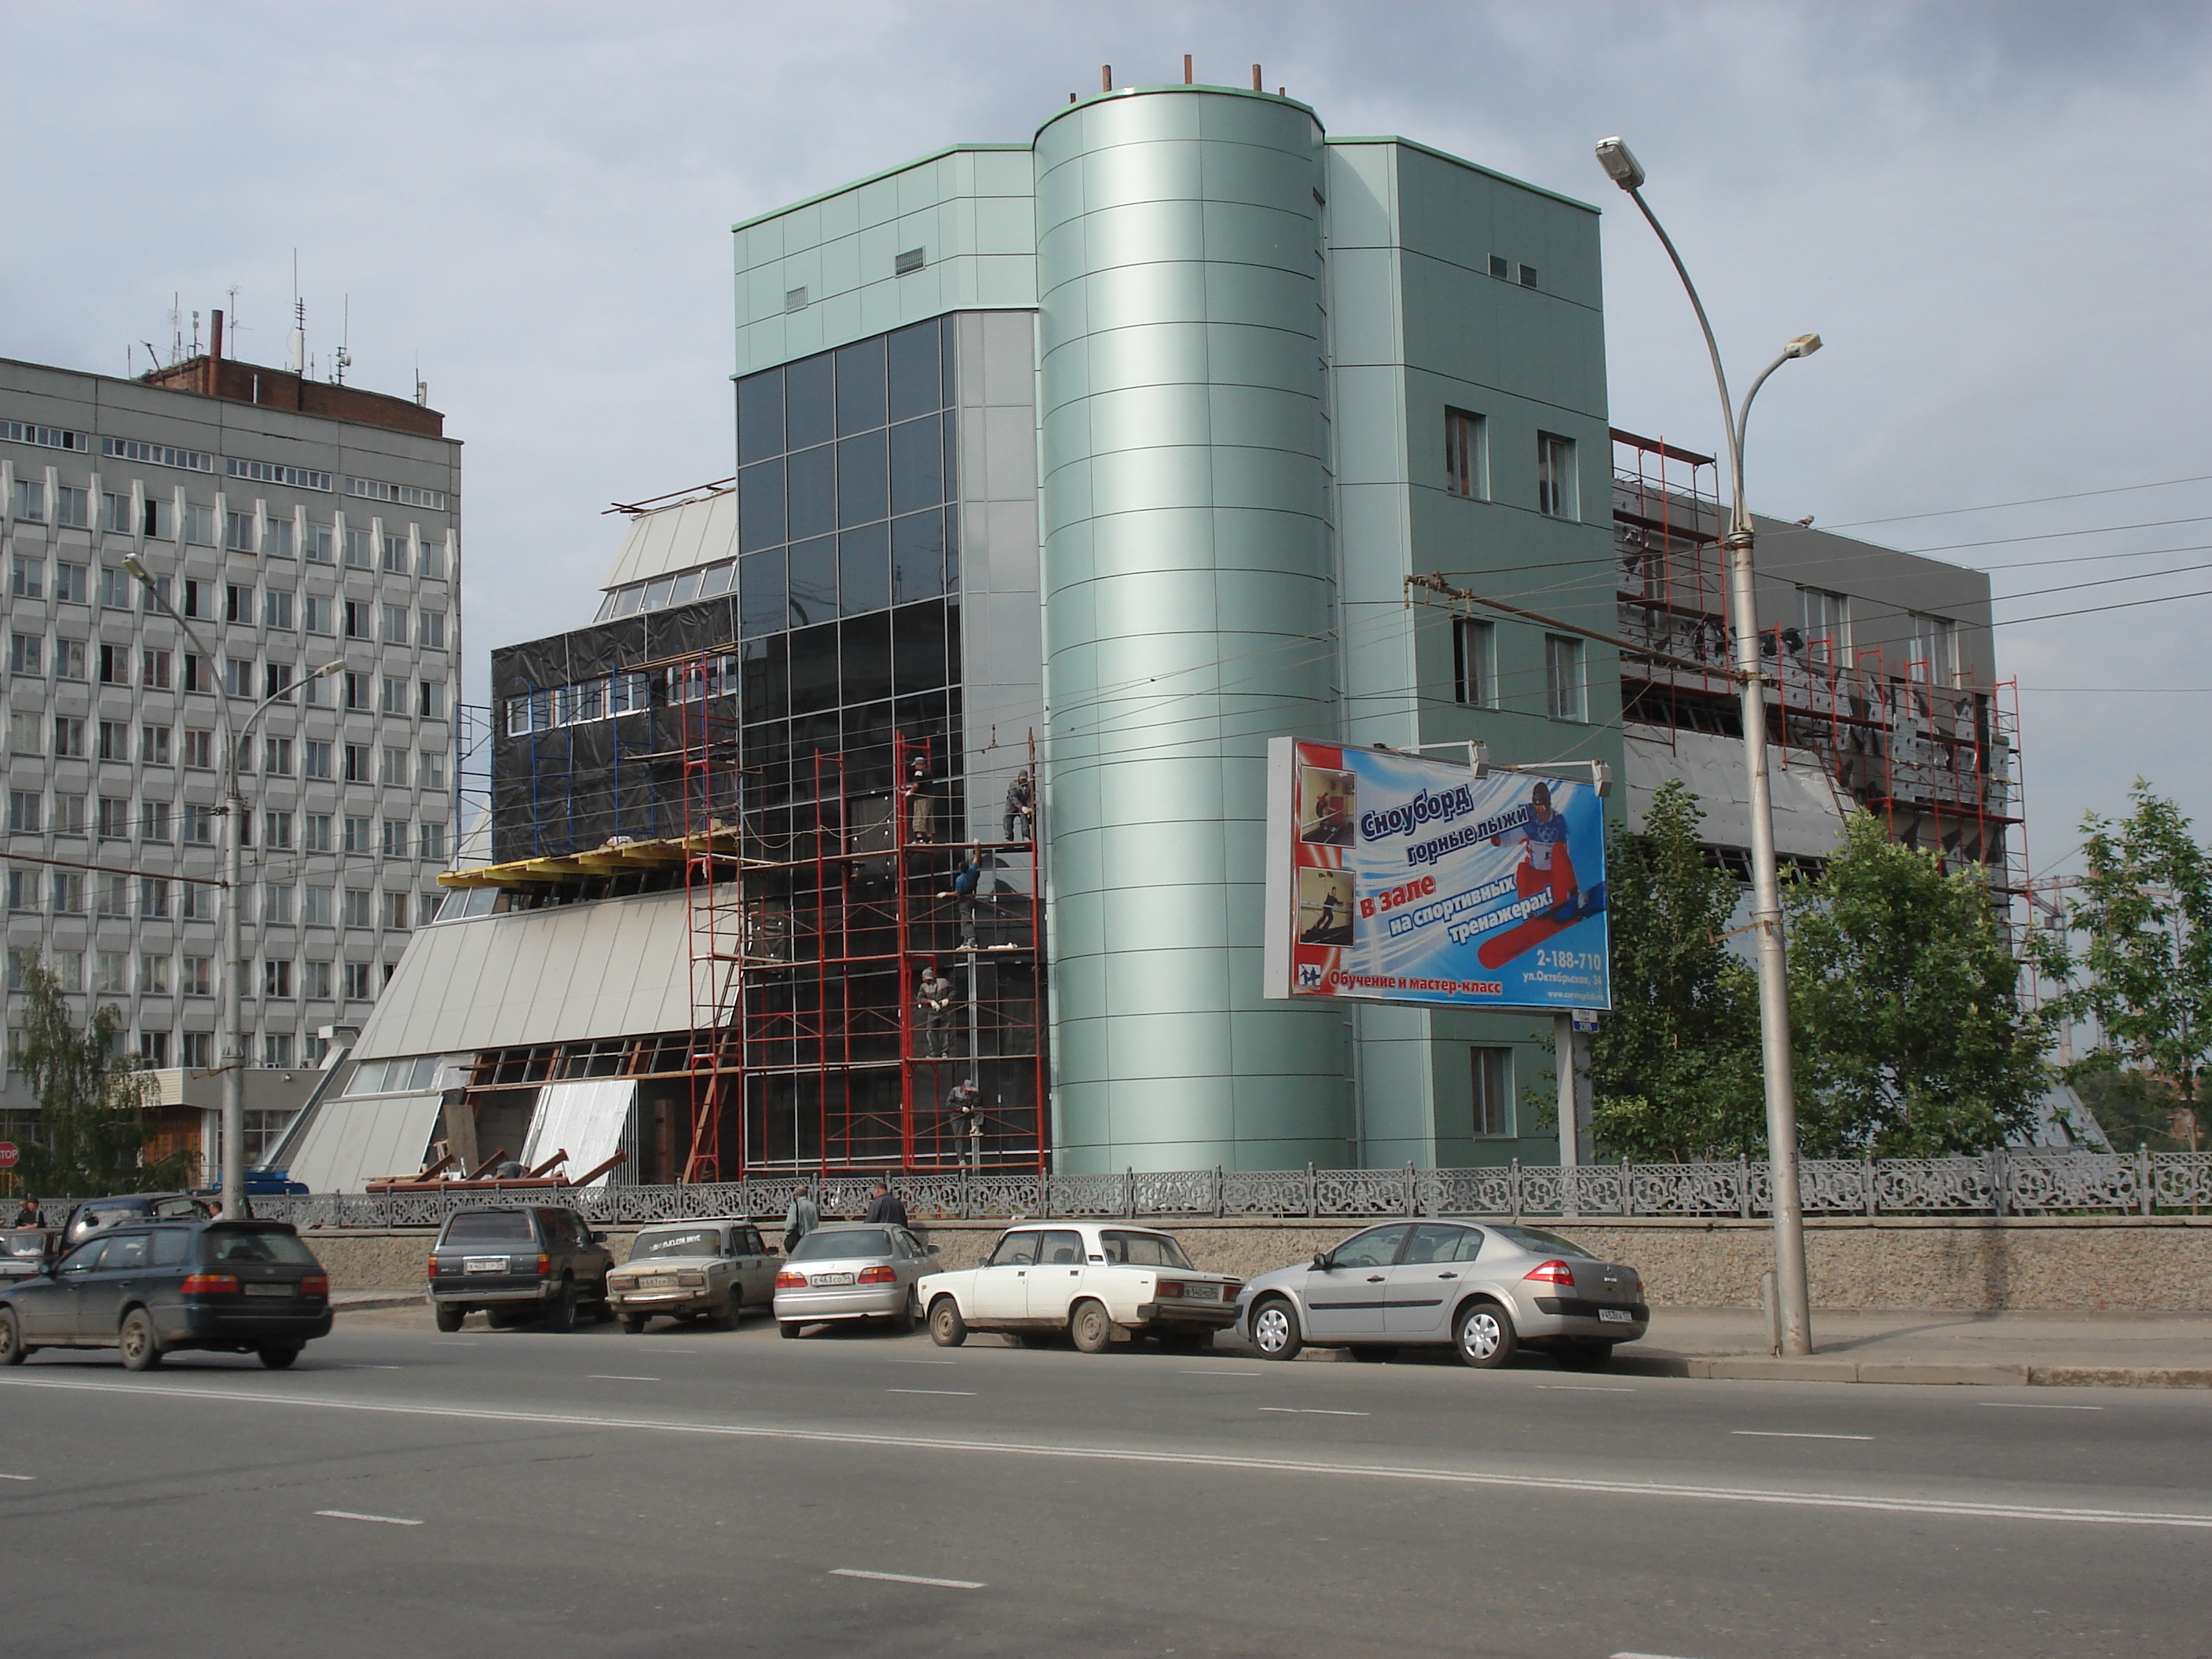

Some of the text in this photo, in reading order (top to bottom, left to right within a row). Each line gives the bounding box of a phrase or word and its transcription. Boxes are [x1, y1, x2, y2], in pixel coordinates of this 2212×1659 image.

[1361, 785, 1473, 840] Сноуборд
[1407, 807, 1529, 865] горные лыжи
[1379, 874, 1437, 912] зале
[1390, 875, 1517, 936] на спортивных
[1449, 885, 1554, 945] тренажерах!
[1329, 971, 1502, 995] Обучение и мастер-класс
[1536, 949, 1602, 971] 2-188-710
